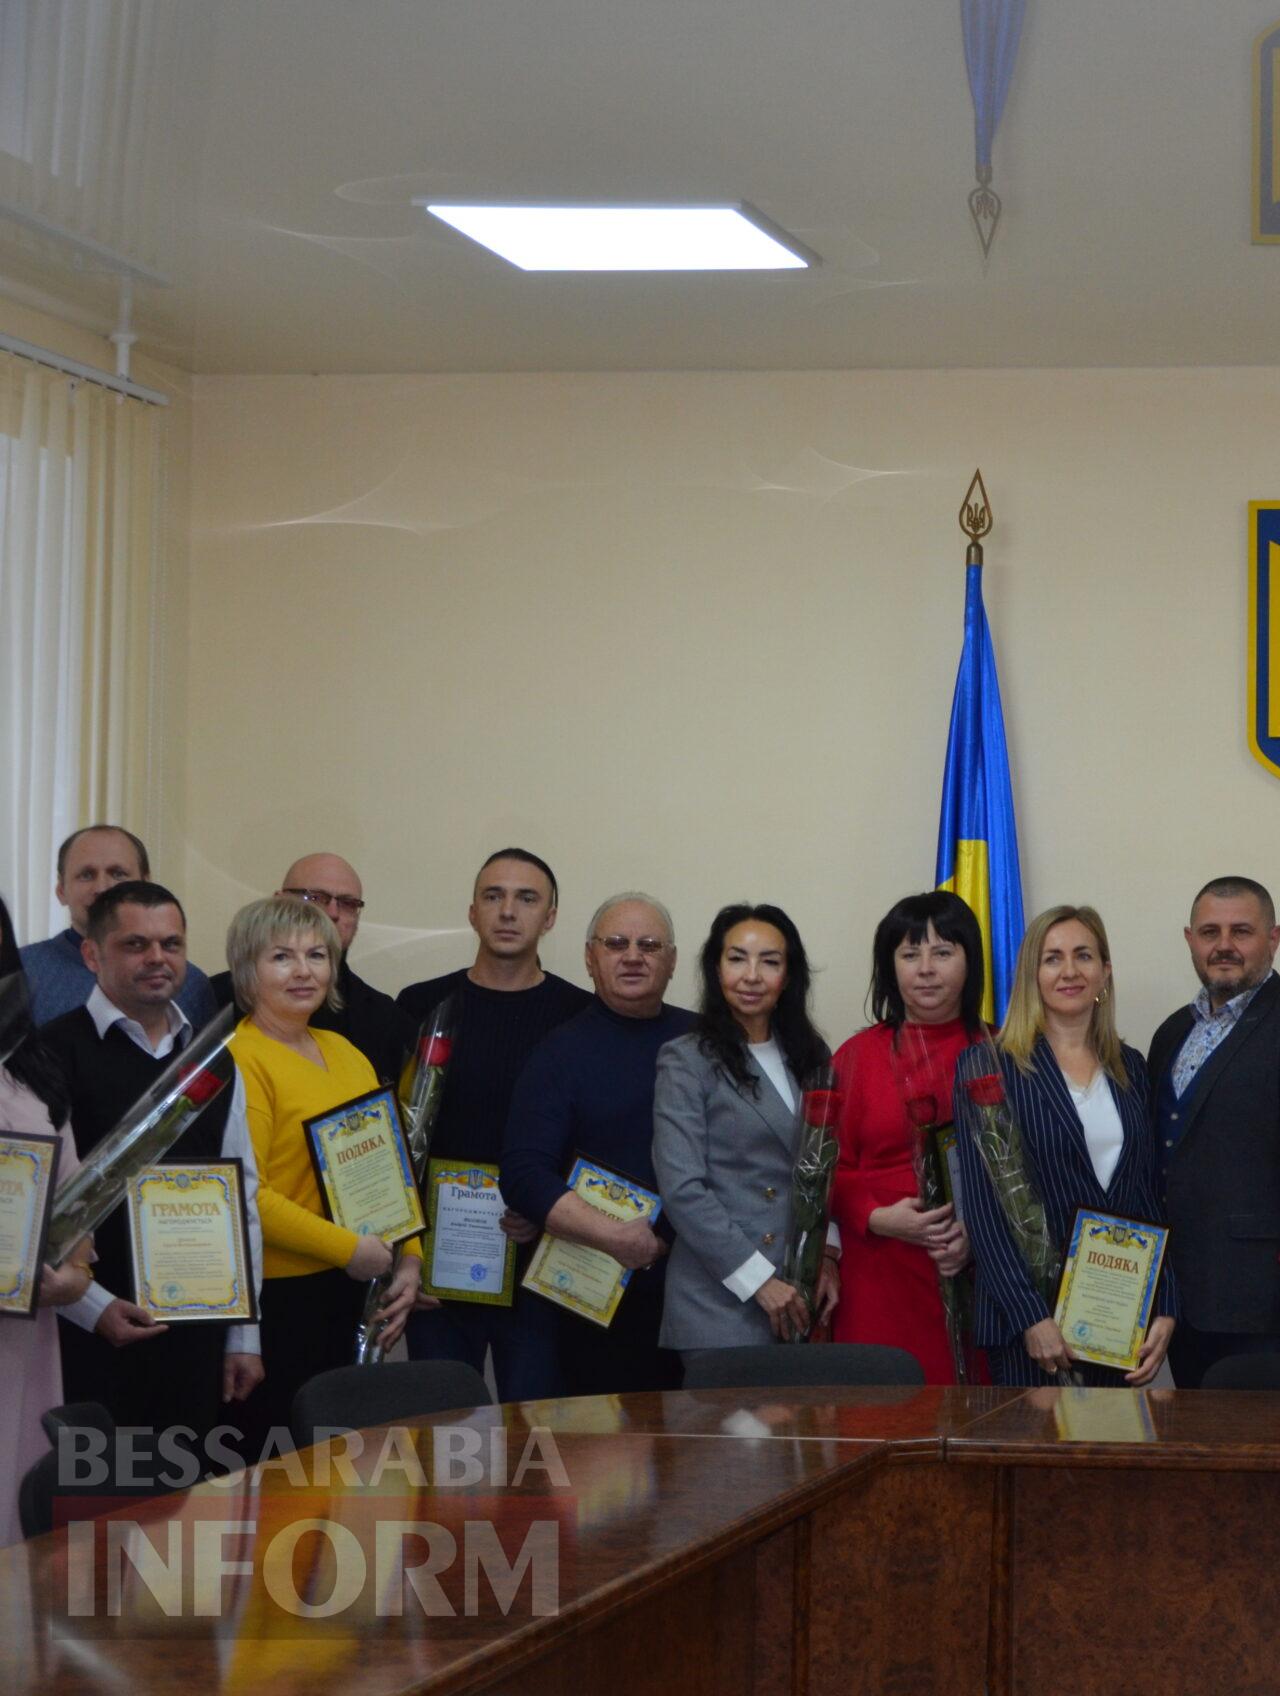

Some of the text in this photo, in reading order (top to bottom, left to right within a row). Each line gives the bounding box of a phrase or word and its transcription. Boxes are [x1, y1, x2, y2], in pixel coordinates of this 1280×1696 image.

[336, 1134, 386, 1165] ПОДЯКА
[450, 1186, 497, 1201] Грамота
[150, 1202, 221, 1217] ГРАМОТА
[1087, 1250, 1140, 1275] ПОДЯКА
